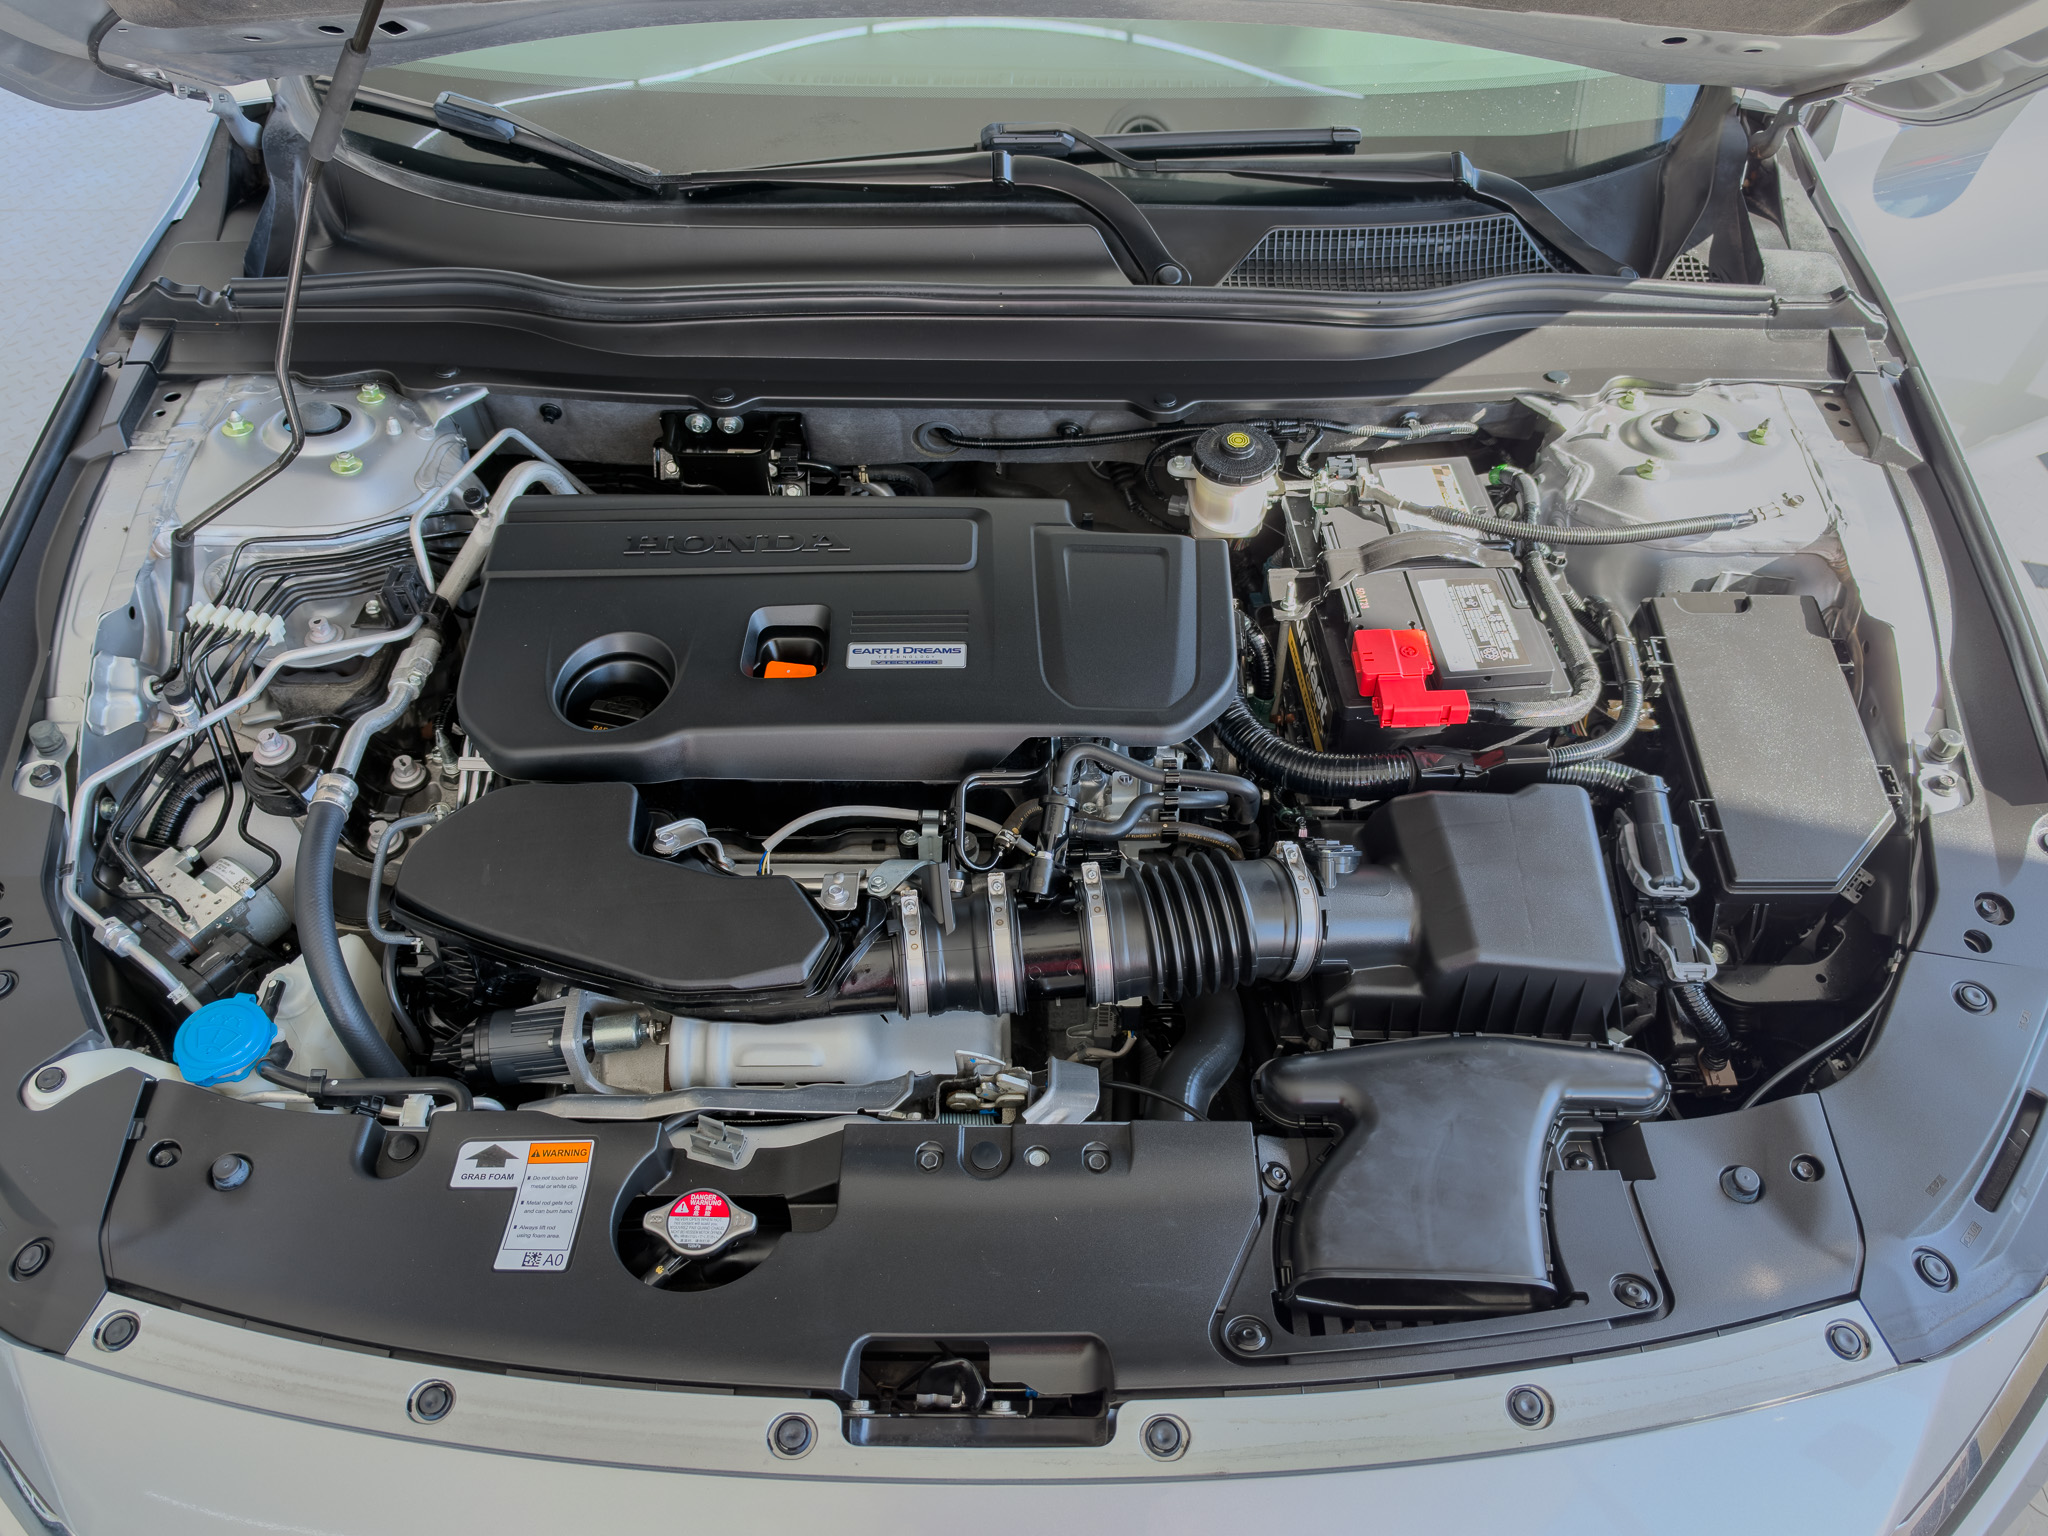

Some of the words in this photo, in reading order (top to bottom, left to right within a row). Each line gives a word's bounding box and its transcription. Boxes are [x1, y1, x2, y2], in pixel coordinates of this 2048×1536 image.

[623, 534, 851, 555] HONDA
[542, 1148, 588, 1158] WARNING
[543, 1254, 564, 1266] A0
